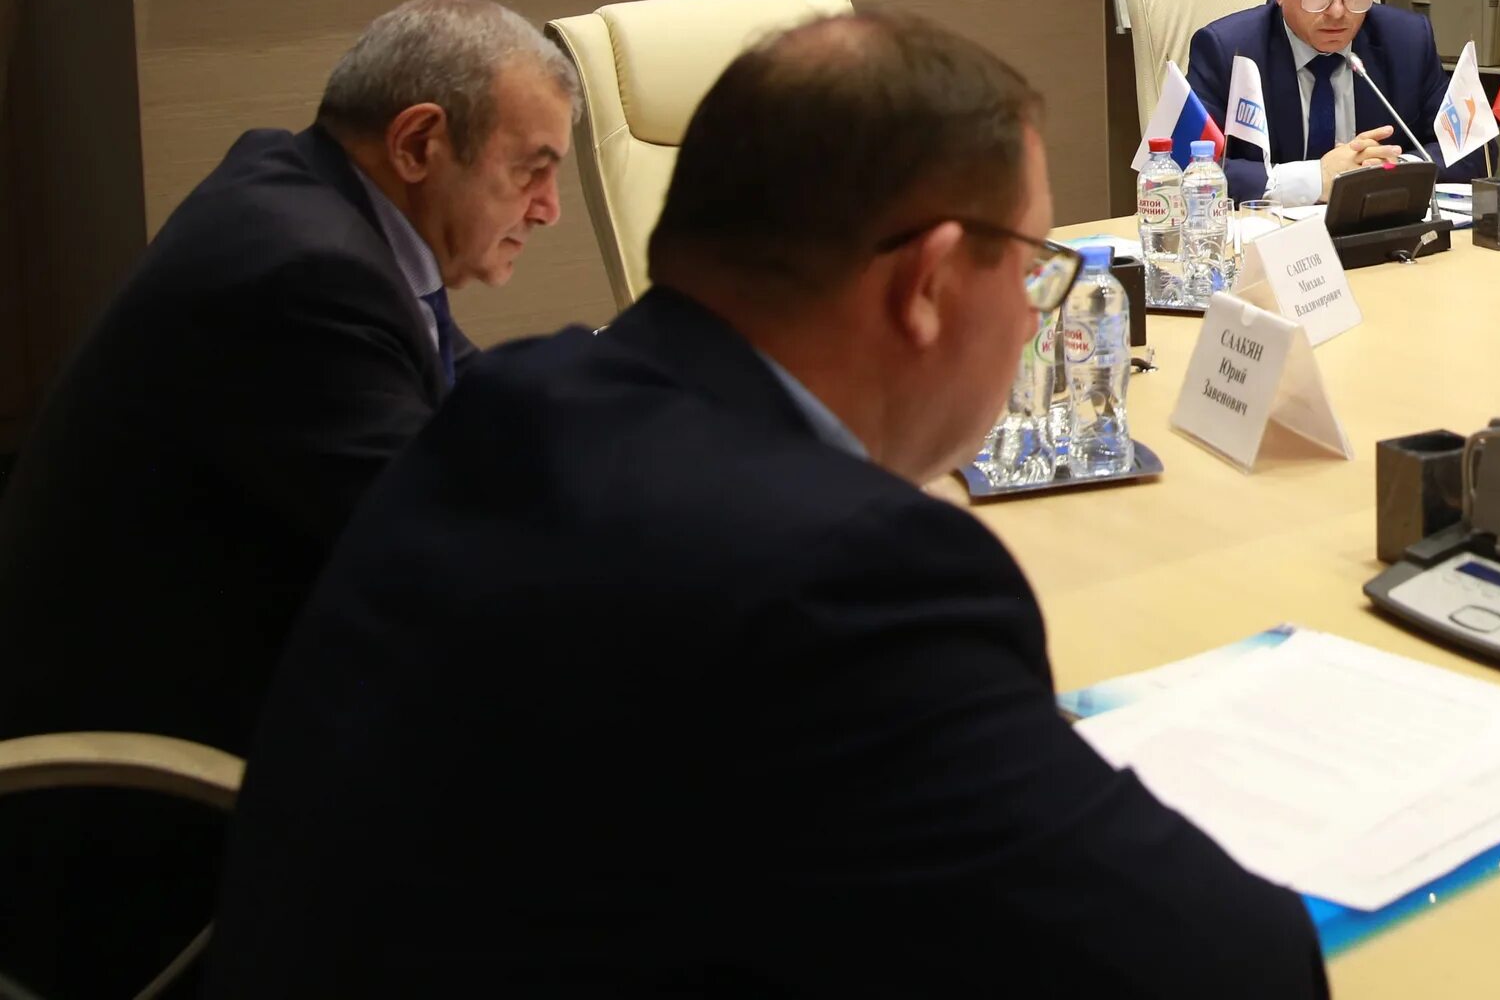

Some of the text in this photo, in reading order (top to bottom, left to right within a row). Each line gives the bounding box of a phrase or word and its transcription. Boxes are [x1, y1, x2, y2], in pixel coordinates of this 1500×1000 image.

[1139, 207, 1167, 216] точник
[1286, 252, 1323, 278] САПЕТОВ
[1297, 274, 1326, 294] Михаил
[1294, 290, 1343, 318] Владимирович
[1220, 328, 1265, 362] СААКЯН
[1218, 356, 1248, 385] Юрий
[1200, 378, 1248, 417] Завенович
